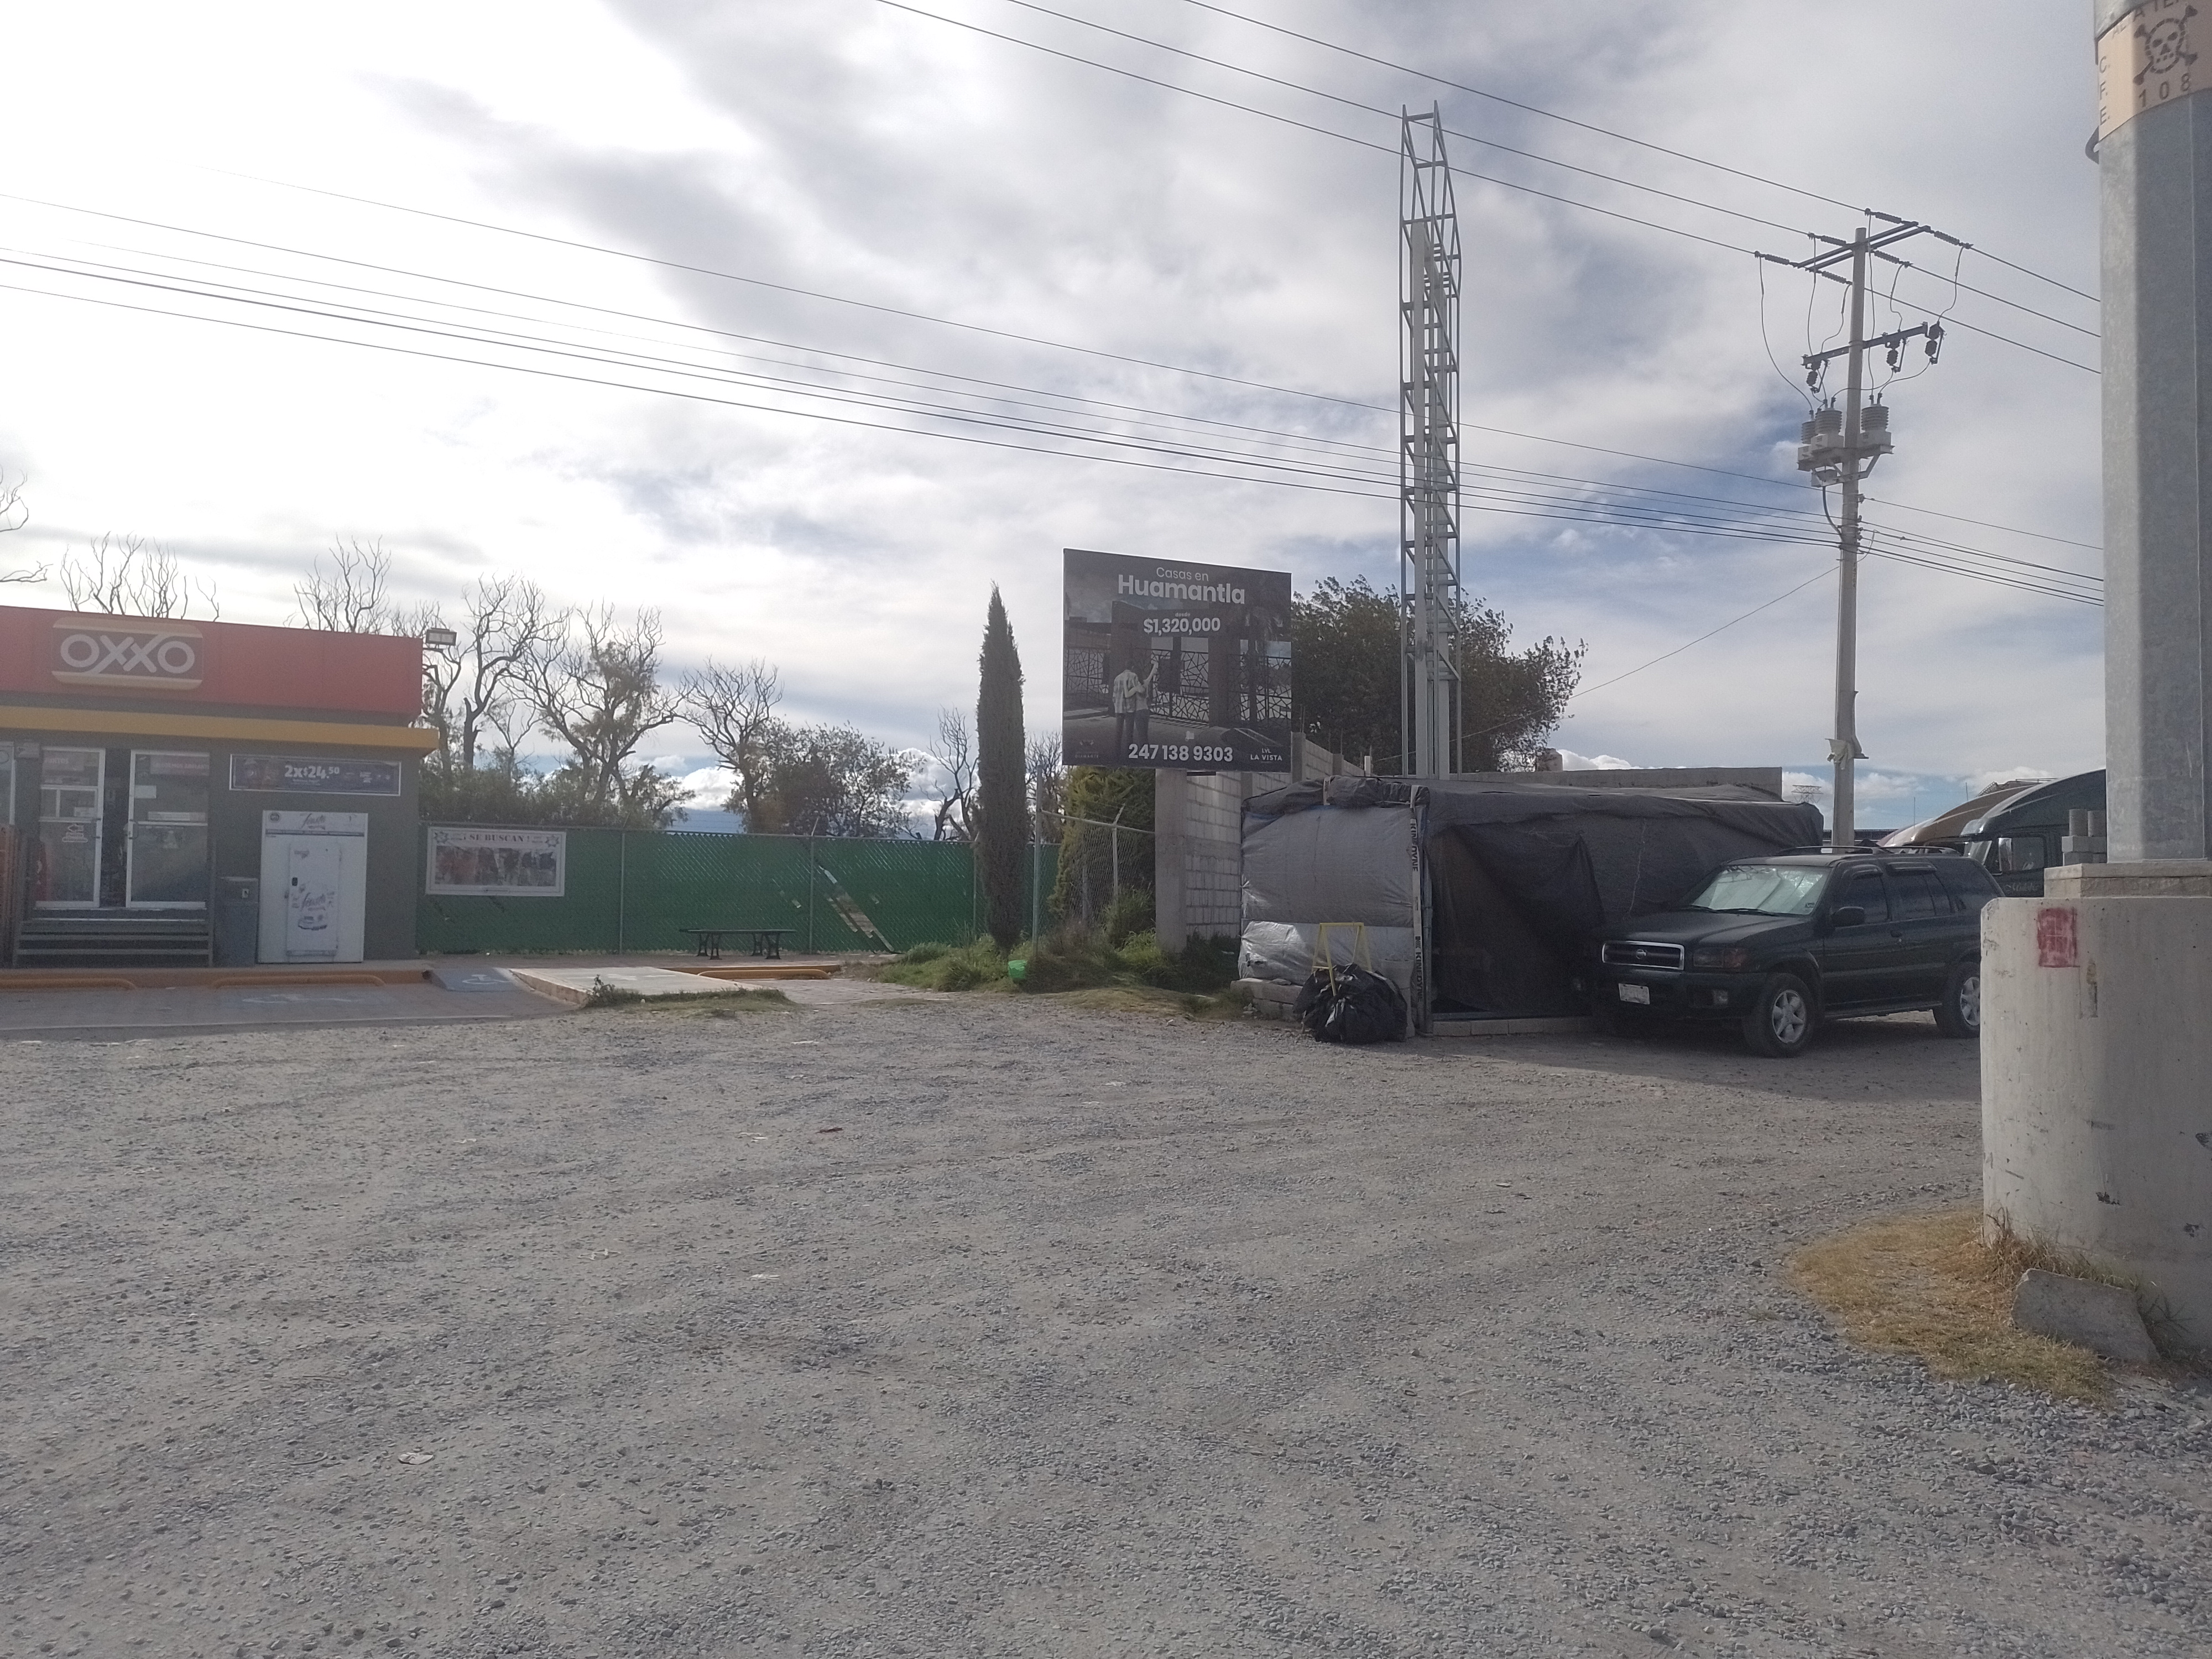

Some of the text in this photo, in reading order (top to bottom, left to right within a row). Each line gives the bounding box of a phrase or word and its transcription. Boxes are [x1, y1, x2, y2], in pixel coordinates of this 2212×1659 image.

[1156, 567, 1209, 581] Casas en
[1118, 574, 1245, 604] Huamantla
[1144, 617, 1221, 635] $1,320,000
[60, 633, 195, 674] OXXO
[1128, 743, 1233, 762] 247 138 9303
[485, 834, 524, 842] BUSCAN
